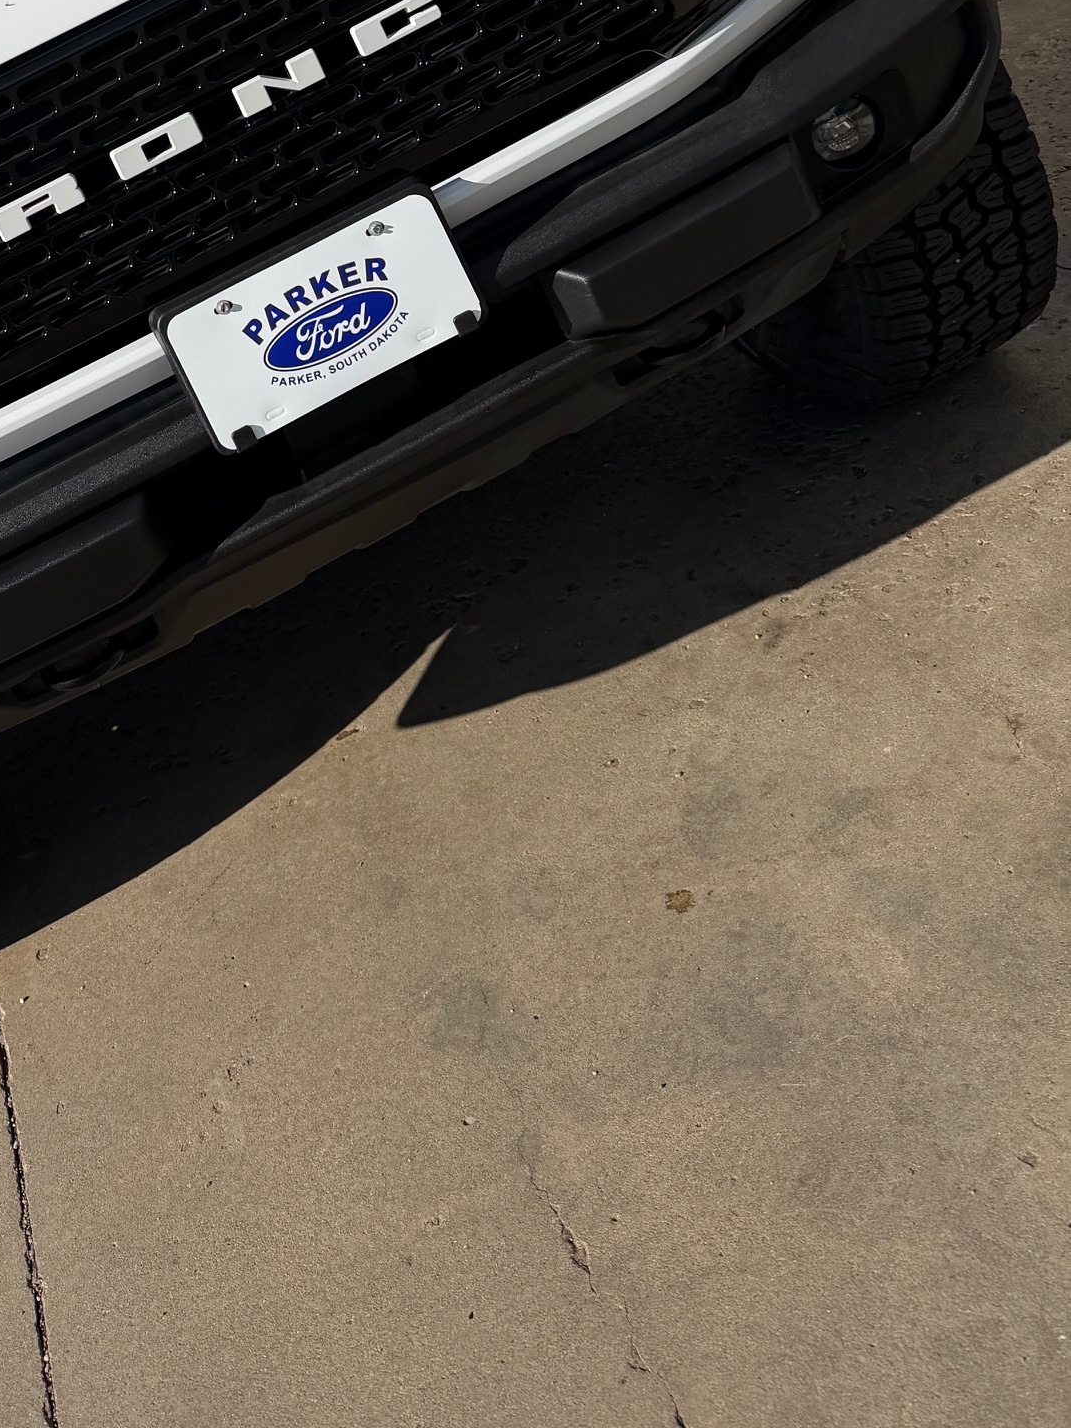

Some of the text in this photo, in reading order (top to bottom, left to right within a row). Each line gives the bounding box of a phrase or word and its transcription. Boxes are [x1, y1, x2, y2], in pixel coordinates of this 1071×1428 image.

[242, 257, 389, 346] PARKER
[295, 301, 371, 362] Ford
[270, 311, 410, 387] PARKER, SOUTH DAKOTA
